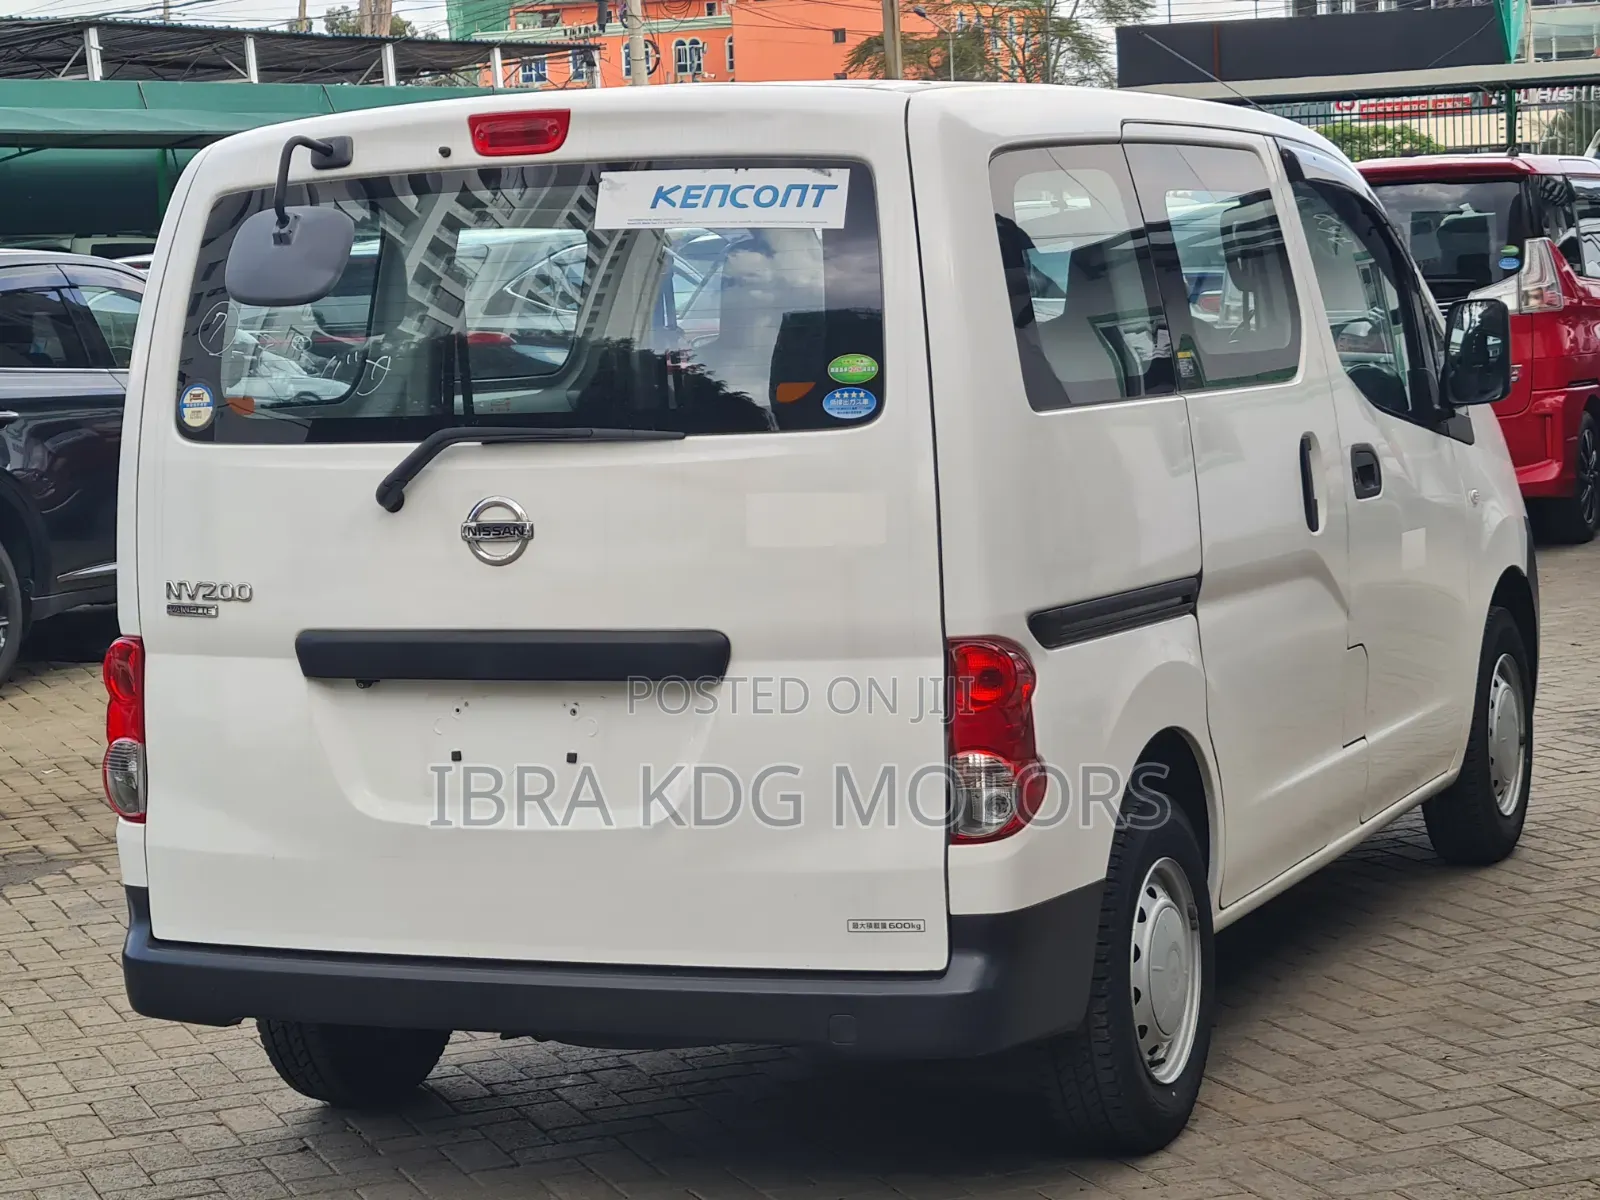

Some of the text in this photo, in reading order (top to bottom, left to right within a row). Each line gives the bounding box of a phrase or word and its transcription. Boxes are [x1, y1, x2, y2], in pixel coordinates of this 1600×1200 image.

[649, 183, 839, 209] KENCONT
[467, 526, 525, 537] NISSAN
[165, 580, 253, 602] NV200
